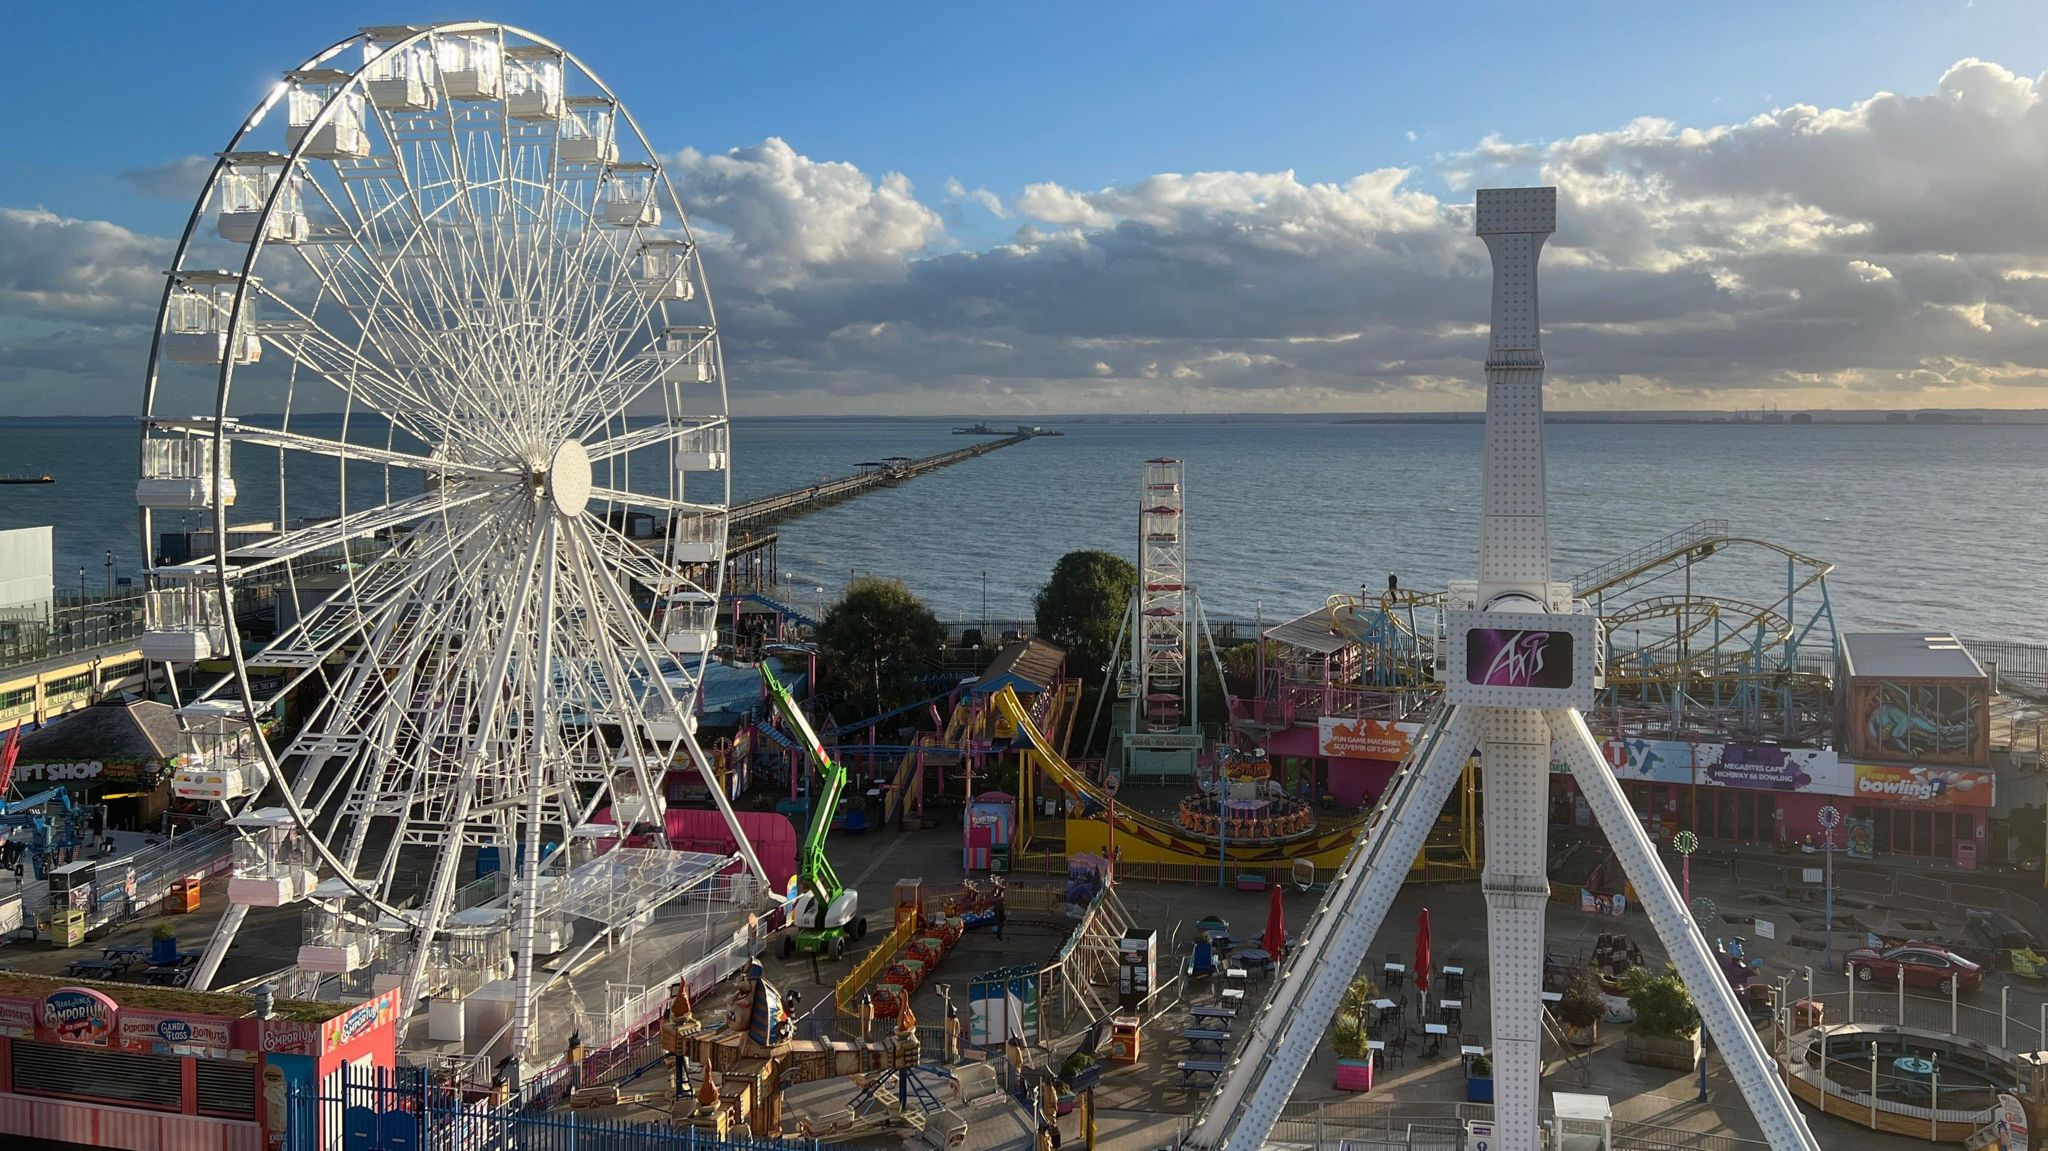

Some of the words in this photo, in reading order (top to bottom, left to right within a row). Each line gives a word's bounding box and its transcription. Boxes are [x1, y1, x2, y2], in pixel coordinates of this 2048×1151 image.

[1367, 738, 1401, 746] MACHINES
[1333, 743, 1366, 751] SOUVENIR
[1382, 746, 1400, 754] SHOP
[46, 761, 103, 781] SHOP
[1724, 763, 1764, 772] MEGABITES
[1714, 771, 1748, 779] HIGHWAY
[1759, 774, 1793, 782] BOWLING
[1859, 776, 1940, 800] bowling!
[44, 1003, 108, 1029] EMPORIUM
[123, 1023, 155, 1033] POPCORN
[161, 1022, 185, 1033] CANDY
[166, 1031, 188, 1041] FLOSS
[192, 1026, 227, 1043] DONUTS
[264, 1030, 317, 1051] EMPORIUM
